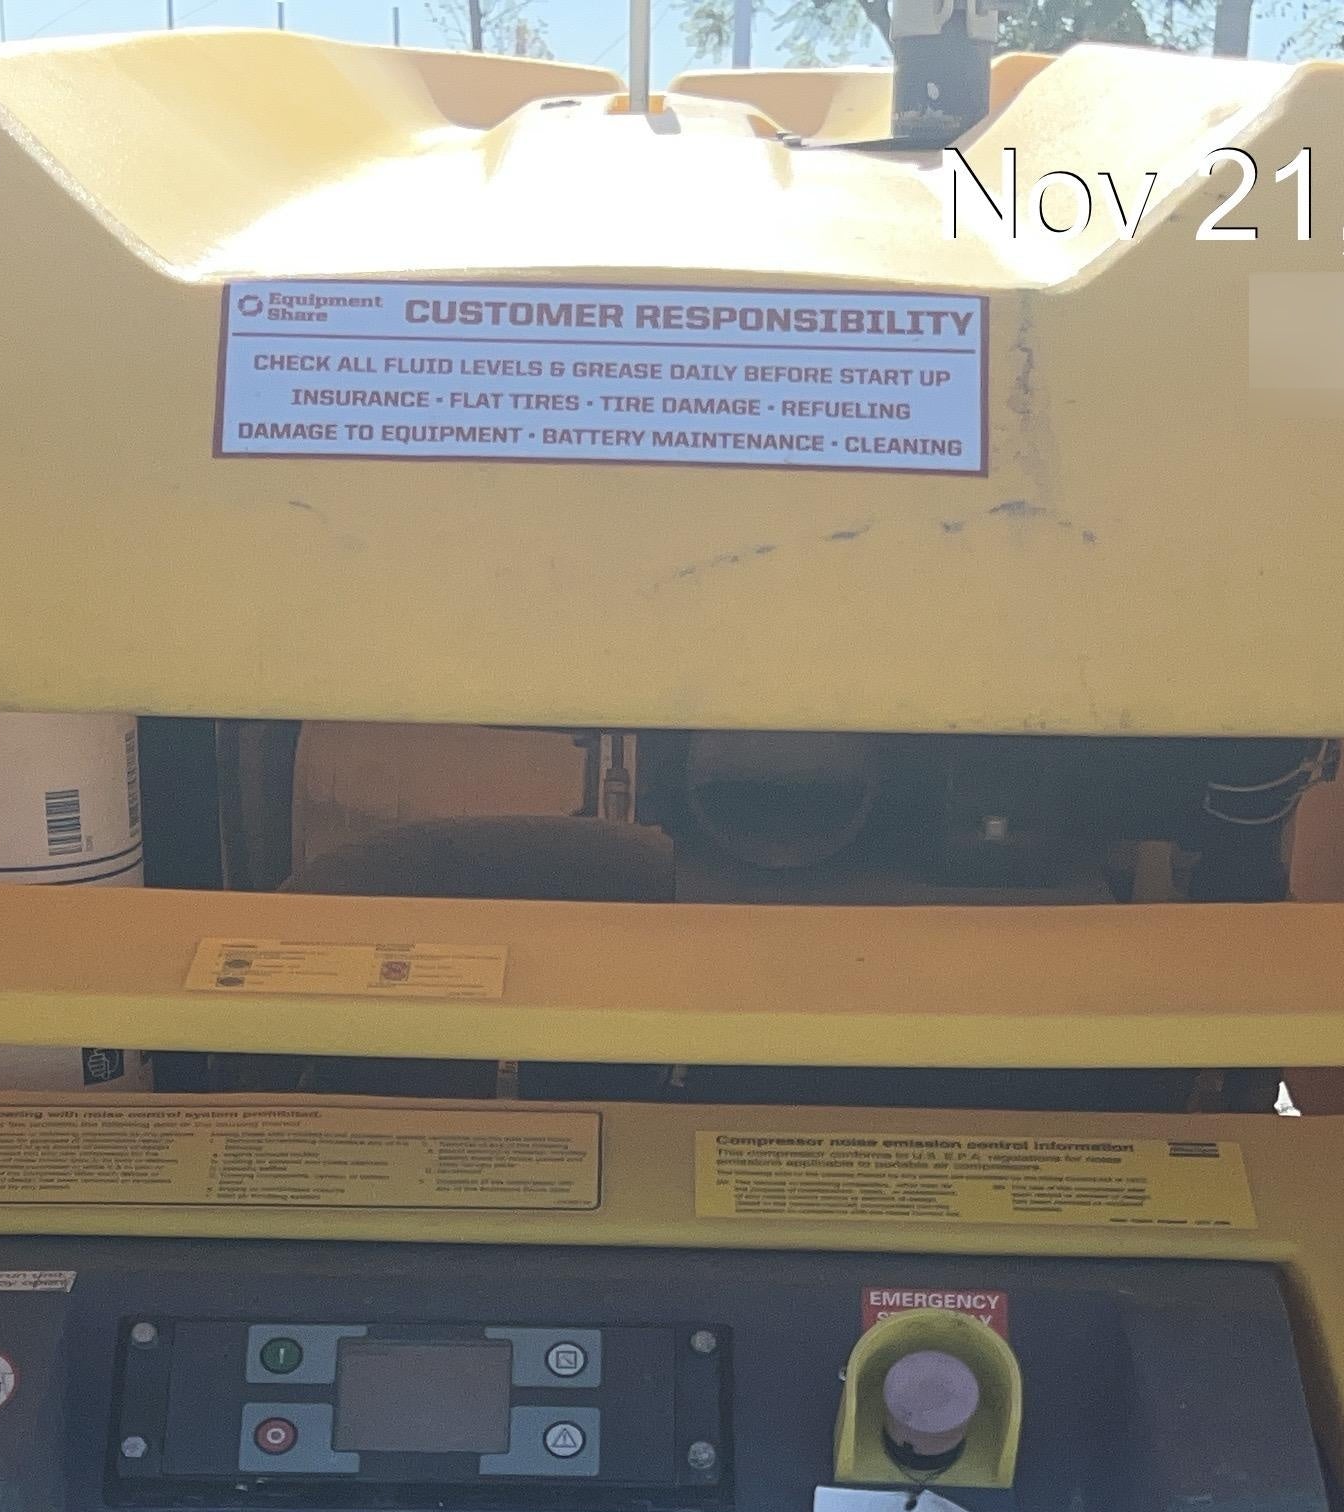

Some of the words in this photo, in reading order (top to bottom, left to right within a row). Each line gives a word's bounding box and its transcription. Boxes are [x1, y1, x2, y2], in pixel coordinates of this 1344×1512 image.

[267, 291, 384, 309] Equipment
[267, 308, 329, 323] Share
[405, 298, 624, 328] CUSTOMER
[635, 302, 976, 337] RESPONSIBILITY
[253, 353, 331, 373] CHECK
[336, 355, 377, 374] ALL
[383, 356, 454, 376] FLUID
[459, 358, 543, 378] LEVELS
[571, 360, 663, 380] GREASE
[669, 363, 738, 382] DAILY
[743, 365, 833, 384] BEFORE
[839, 367, 914, 387] START
[919, 369, 951, 388] UP
[290, 388, 430, 408] INSURANCE
[449, 391, 504, 410] FLAT
[508, 393, 580, 412] TIRES
[599, 394, 655, 413] TIRE
[661, 396, 761, 416] DAMAGE
[780, 399, 911, 421] REFUELING
[237, 421, 338, 441] DAMAGE
[344, 423, 374, 442] TO
[380, 424, 523, 445] EQUIPMENT
[541, 427, 645, 447] BATTERY
[651, 430, 824, 453] MAINTENANCE
[844, 435, 963, 457] CLEANING
[715, 1135, 824, 1148] Compressor
[829, 1137, 878, 1148] noise
[882, 1139, 962, 1150] emission
[966, 1140, 1028, 1151] control
[869, 1291, 1000, 1310] EMERGENCY
